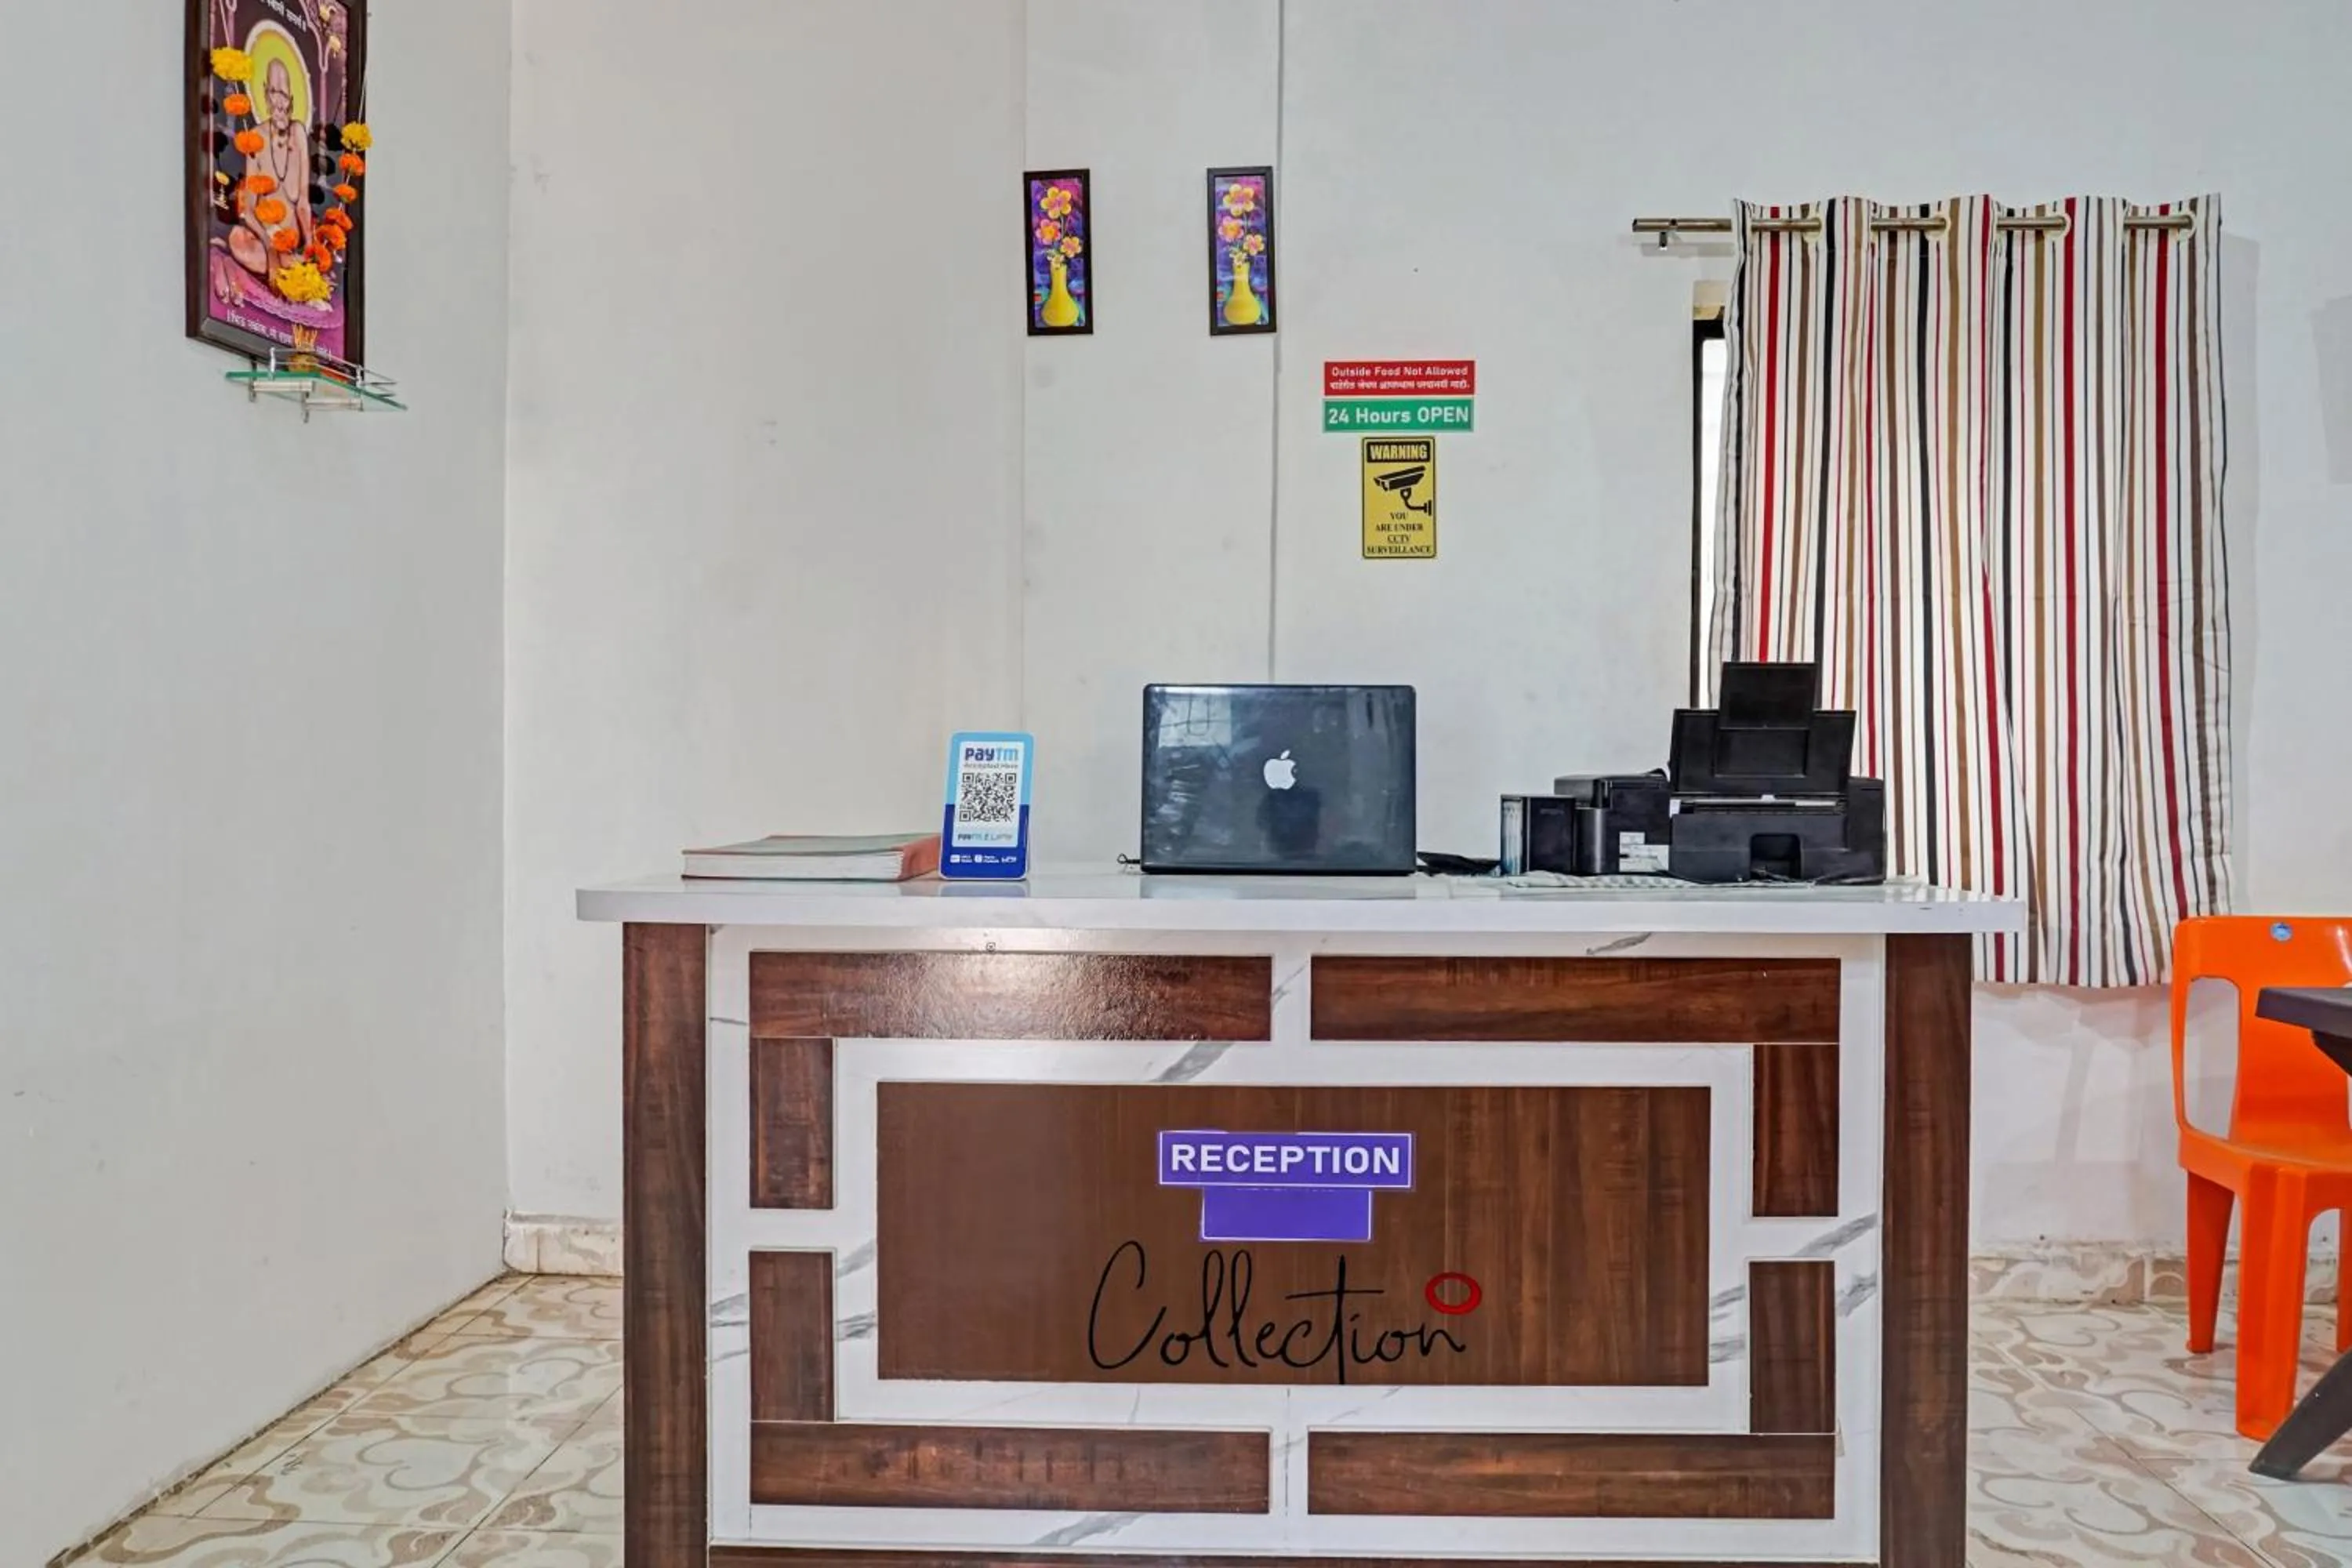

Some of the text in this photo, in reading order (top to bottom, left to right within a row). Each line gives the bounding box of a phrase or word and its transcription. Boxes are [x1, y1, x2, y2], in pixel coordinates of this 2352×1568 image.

[1332, 365, 1468, 376] Outside Food Not Allowed
[1328, 405, 1470, 424] 24 Hours OPEN
[1370, 444, 1429, 461] WARNING
[1389, 511, 1409, 521] YOU
[1375, 522, 1424, 532] ARE UNDER
[1387, 534, 1411, 543] CCTV
[1367, 544, 1432, 554] SURVEILLANCE
[1171, 1143, 1401, 1175] RECEPTION
[1087, 1240, 1466, 1385] Collection
